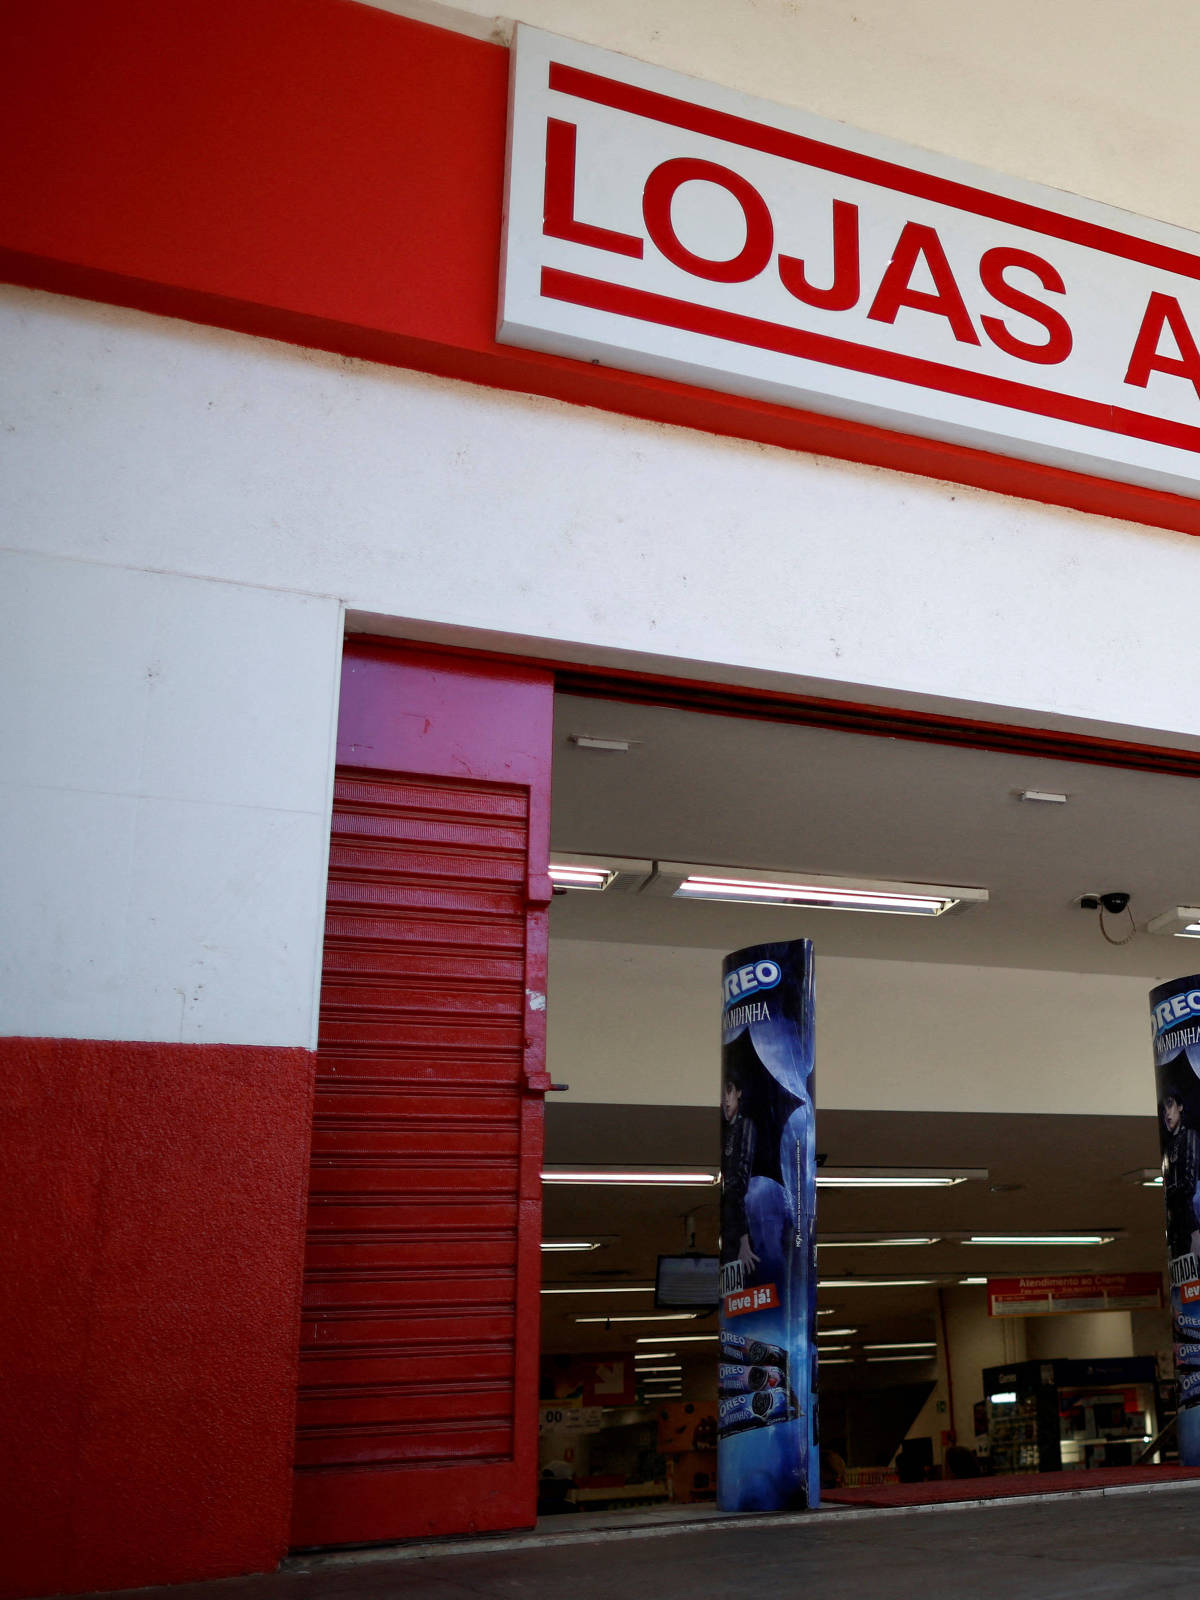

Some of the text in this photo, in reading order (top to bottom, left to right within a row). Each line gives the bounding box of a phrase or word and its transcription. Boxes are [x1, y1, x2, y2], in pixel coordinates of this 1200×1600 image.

[542, 116, 1073, 366] LOJAS
[724, 962, 779, 1003] REO
[726, 1001, 771, 1029] ANDINHA
[1019, 1276, 1079, 1288] Atendimento
[728, 1288, 772, 1312] leve já!
[720, 1395, 746, 1418] OREO
